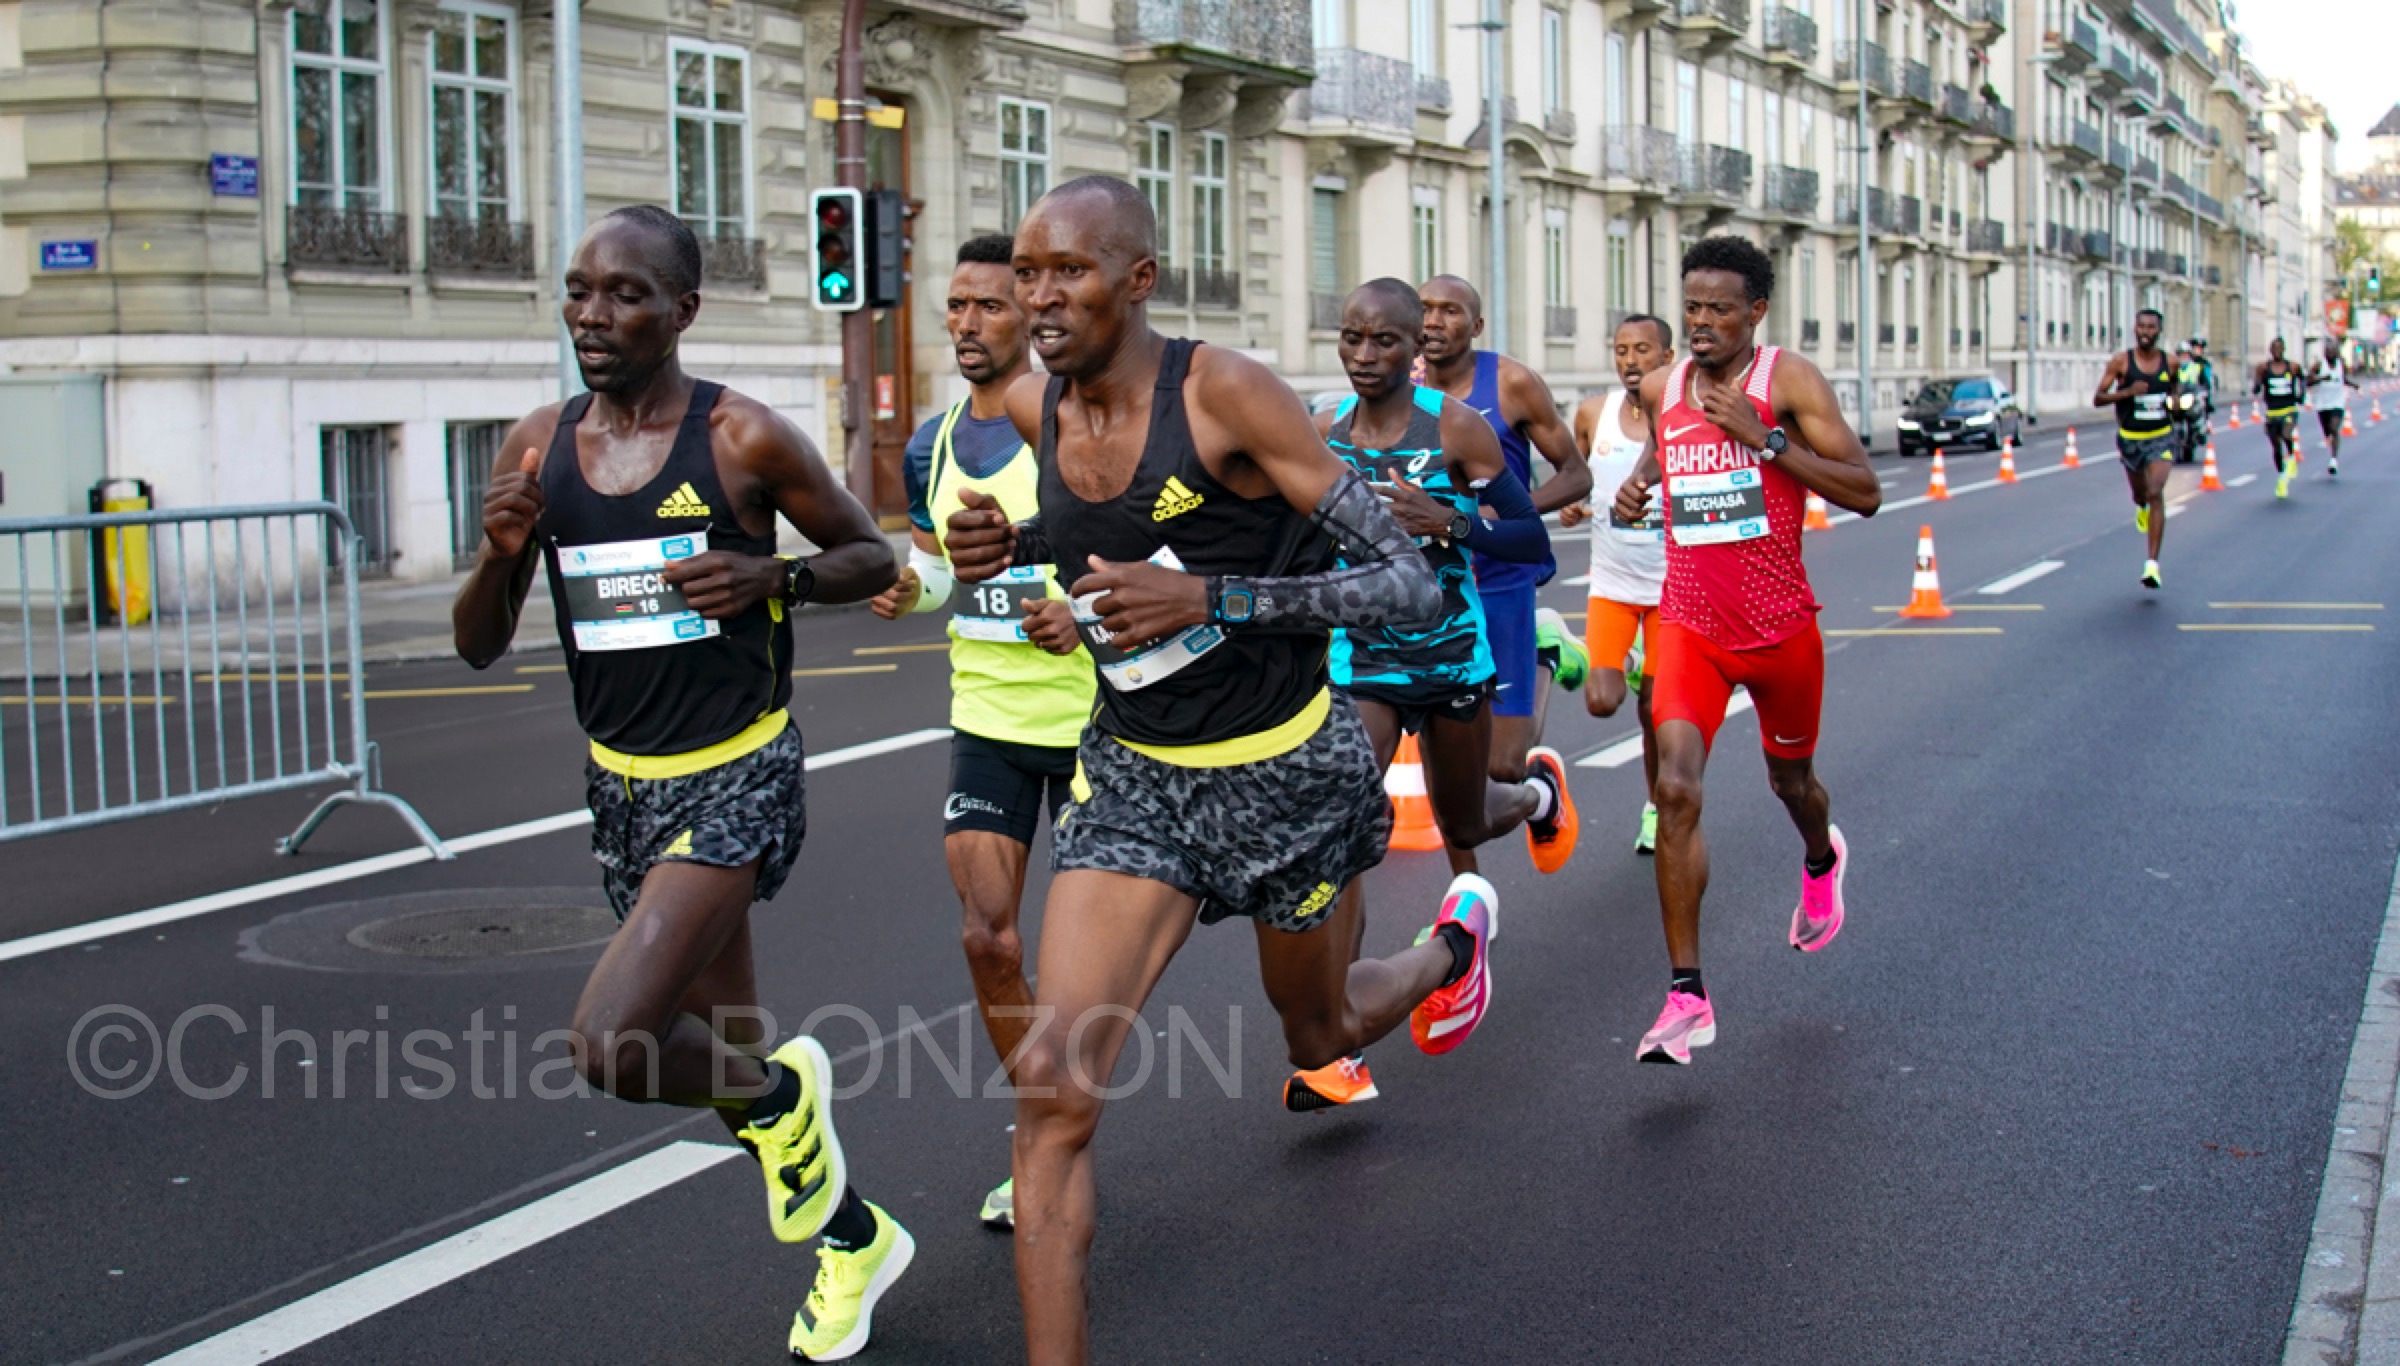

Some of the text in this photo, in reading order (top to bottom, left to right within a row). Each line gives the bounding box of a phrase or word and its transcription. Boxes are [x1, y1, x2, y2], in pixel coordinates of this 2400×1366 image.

[1665, 440, 1761, 474] BAHRAIN
[656, 504, 711, 519] adidas
[1152, 494, 1204, 522] adidas
[1684, 491, 1746, 513] DECHASA
[639, 598, 660, 614] 16
[973, 587, 1011, 615] 18
